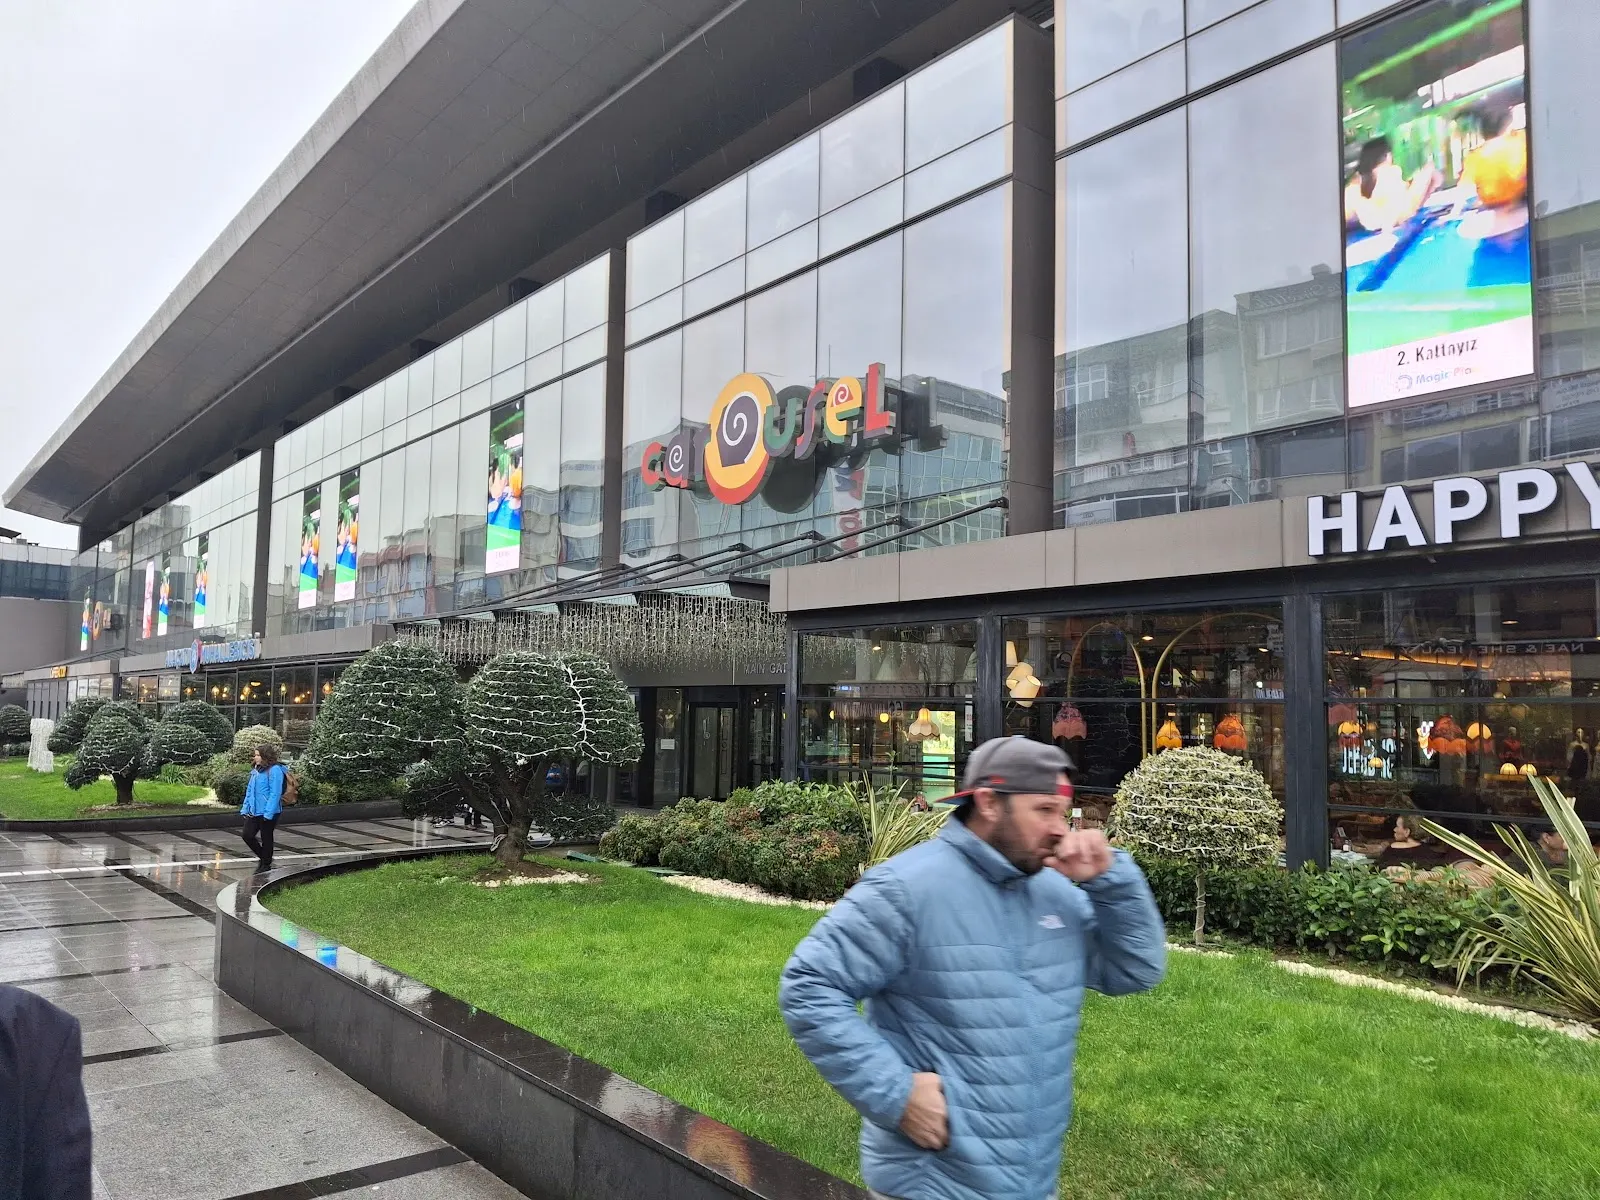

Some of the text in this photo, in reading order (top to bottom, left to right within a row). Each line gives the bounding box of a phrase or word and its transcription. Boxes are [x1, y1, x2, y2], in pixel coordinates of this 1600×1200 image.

[1396, 350, 1410, 367] 2.
[1415, 370, 1450, 386] Magic
[1307, 461, 1600, 557] HAPPY
[743, 662, 788, 675] MAIN GAT
